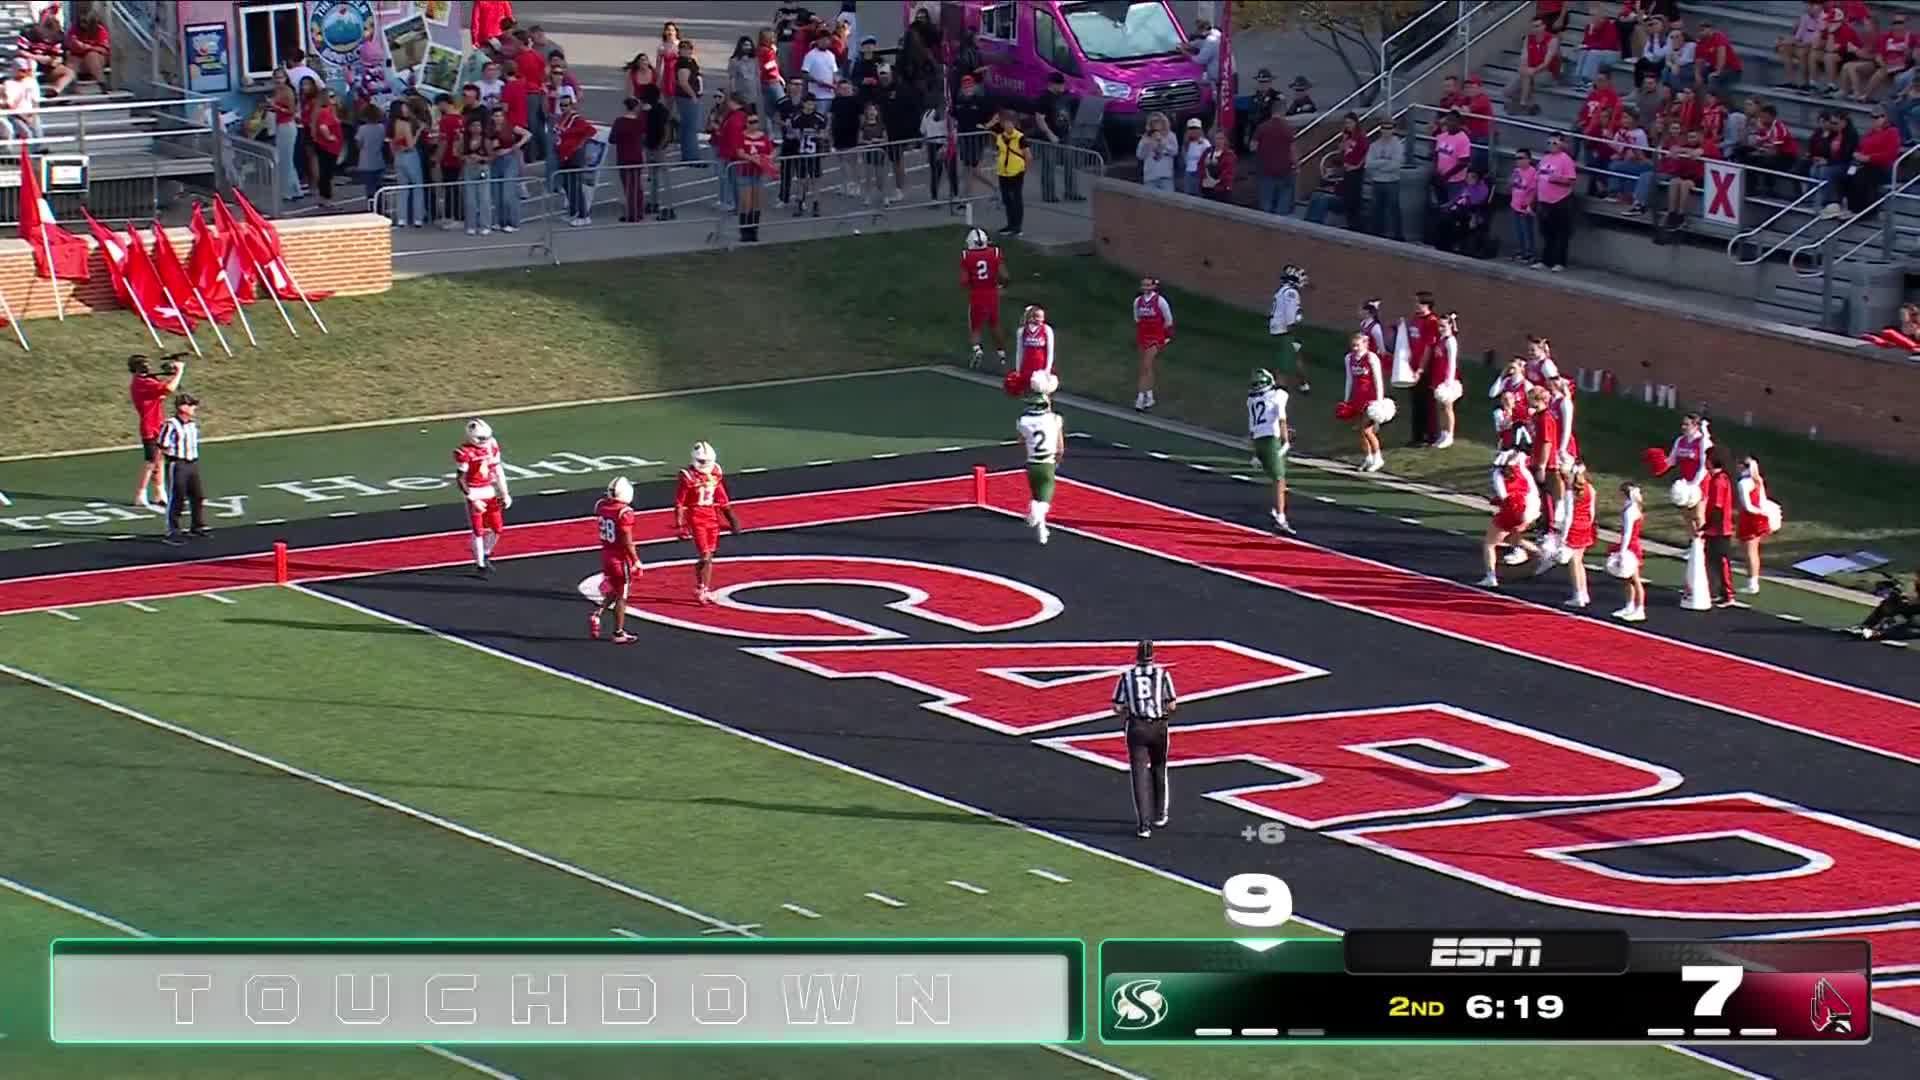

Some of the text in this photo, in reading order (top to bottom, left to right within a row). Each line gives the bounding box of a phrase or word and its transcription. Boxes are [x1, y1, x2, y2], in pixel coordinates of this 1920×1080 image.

[1708, 169, 1736, 219] X
[975, 260, 989, 280] 2
[1251, 400, 1267, 426] 12
[1032, 429, 1048, 453] 2
[258, 451, 668, 503] Helth
[1135, 675, 1153, 700] B
